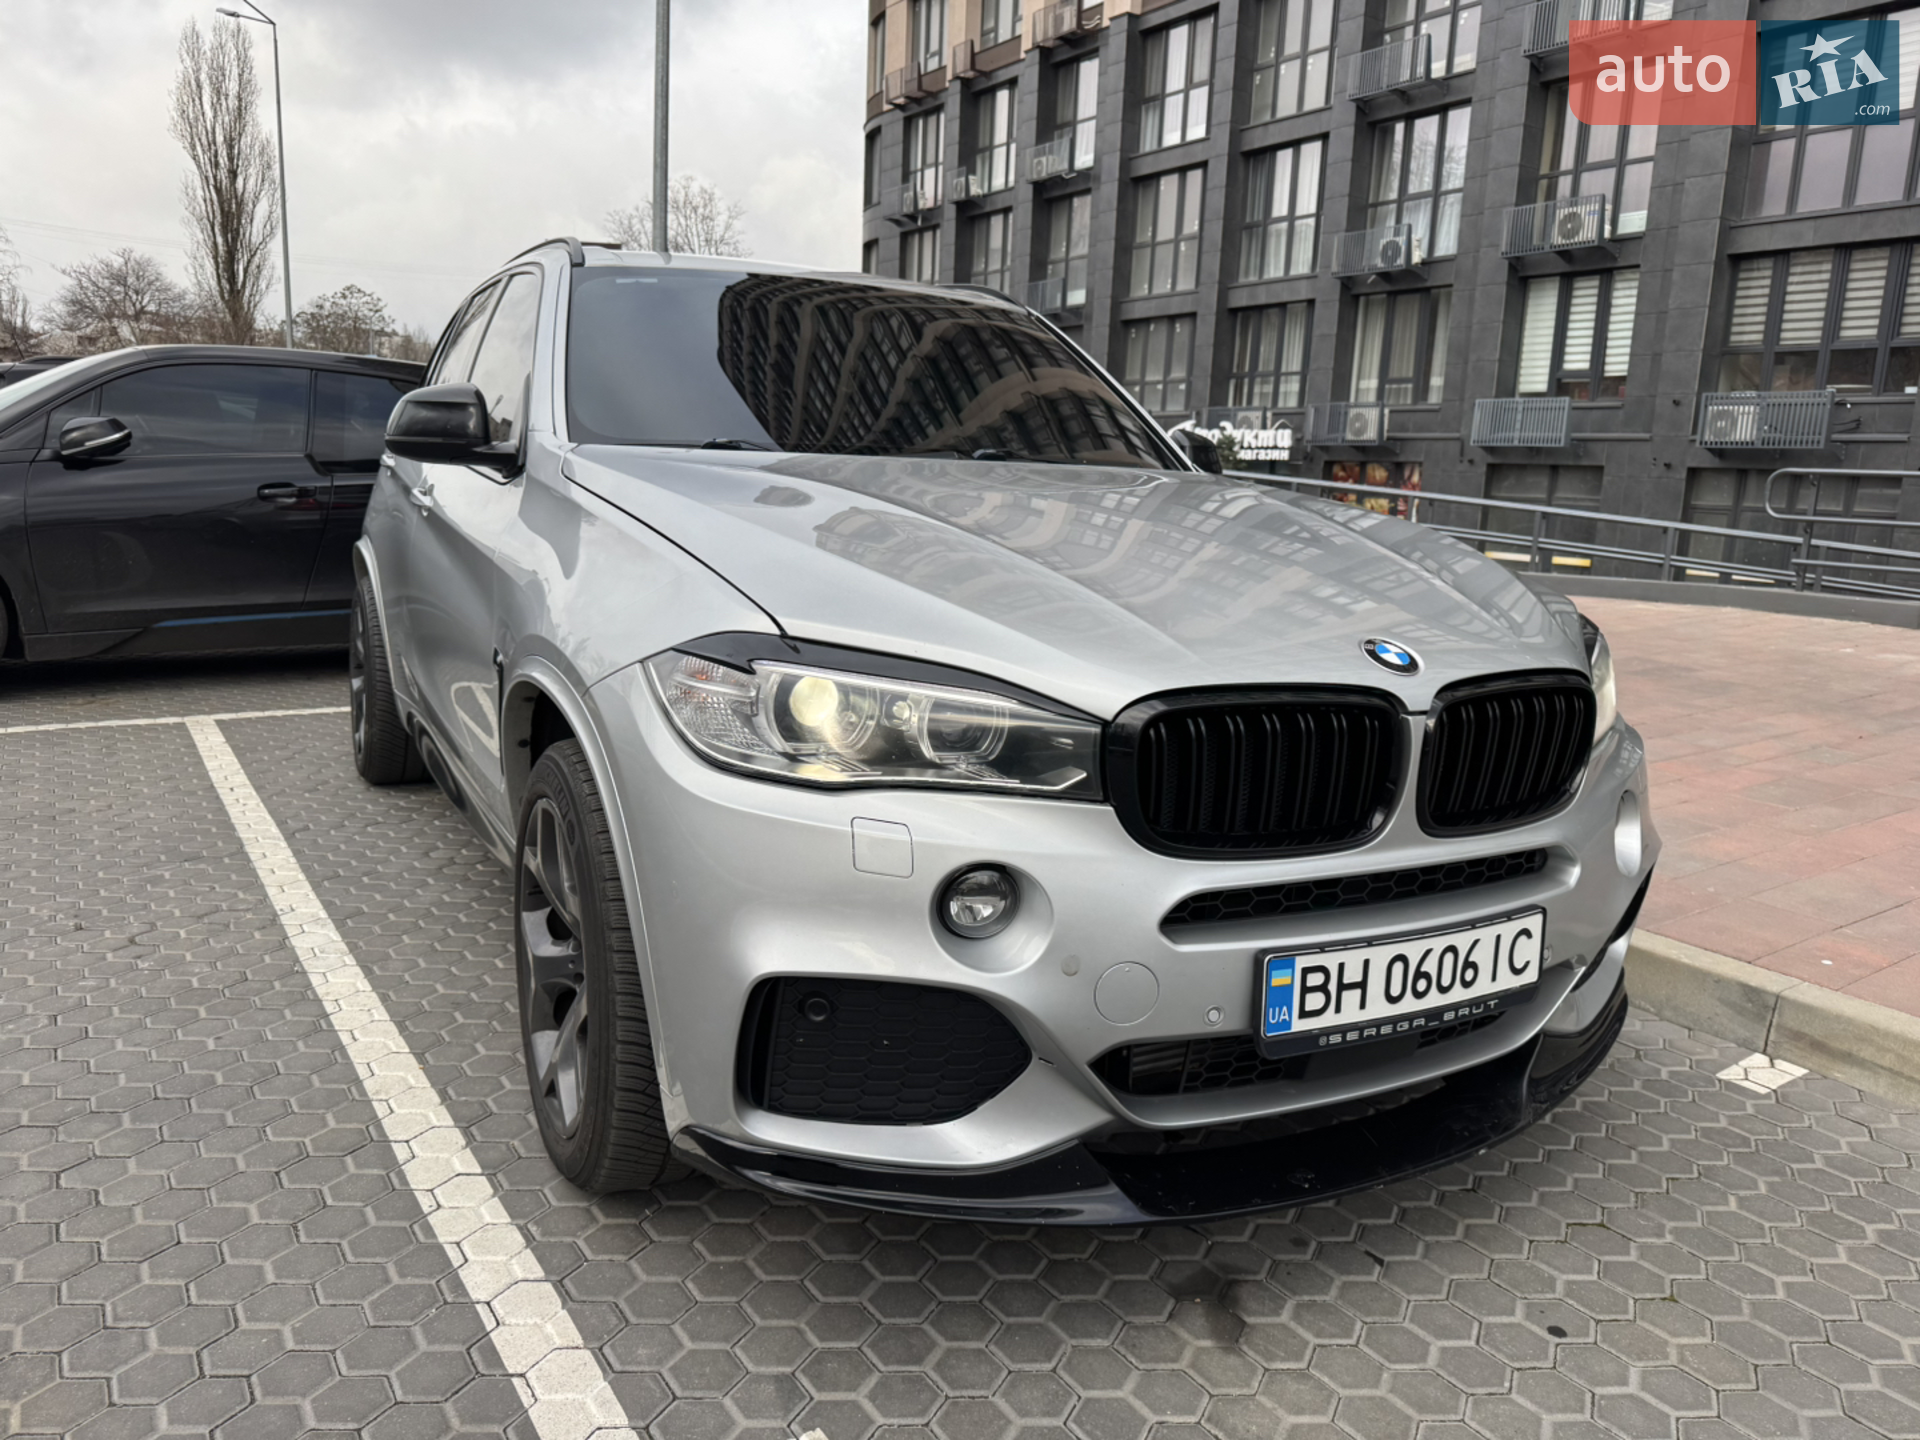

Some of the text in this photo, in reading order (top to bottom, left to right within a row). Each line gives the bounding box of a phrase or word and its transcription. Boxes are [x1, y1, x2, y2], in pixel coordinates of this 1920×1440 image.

[1298, 957, 1370, 1020] BH
[1384, 938, 1481, 1005] 0606
[1268, 1004, 1290, 1024] UA
